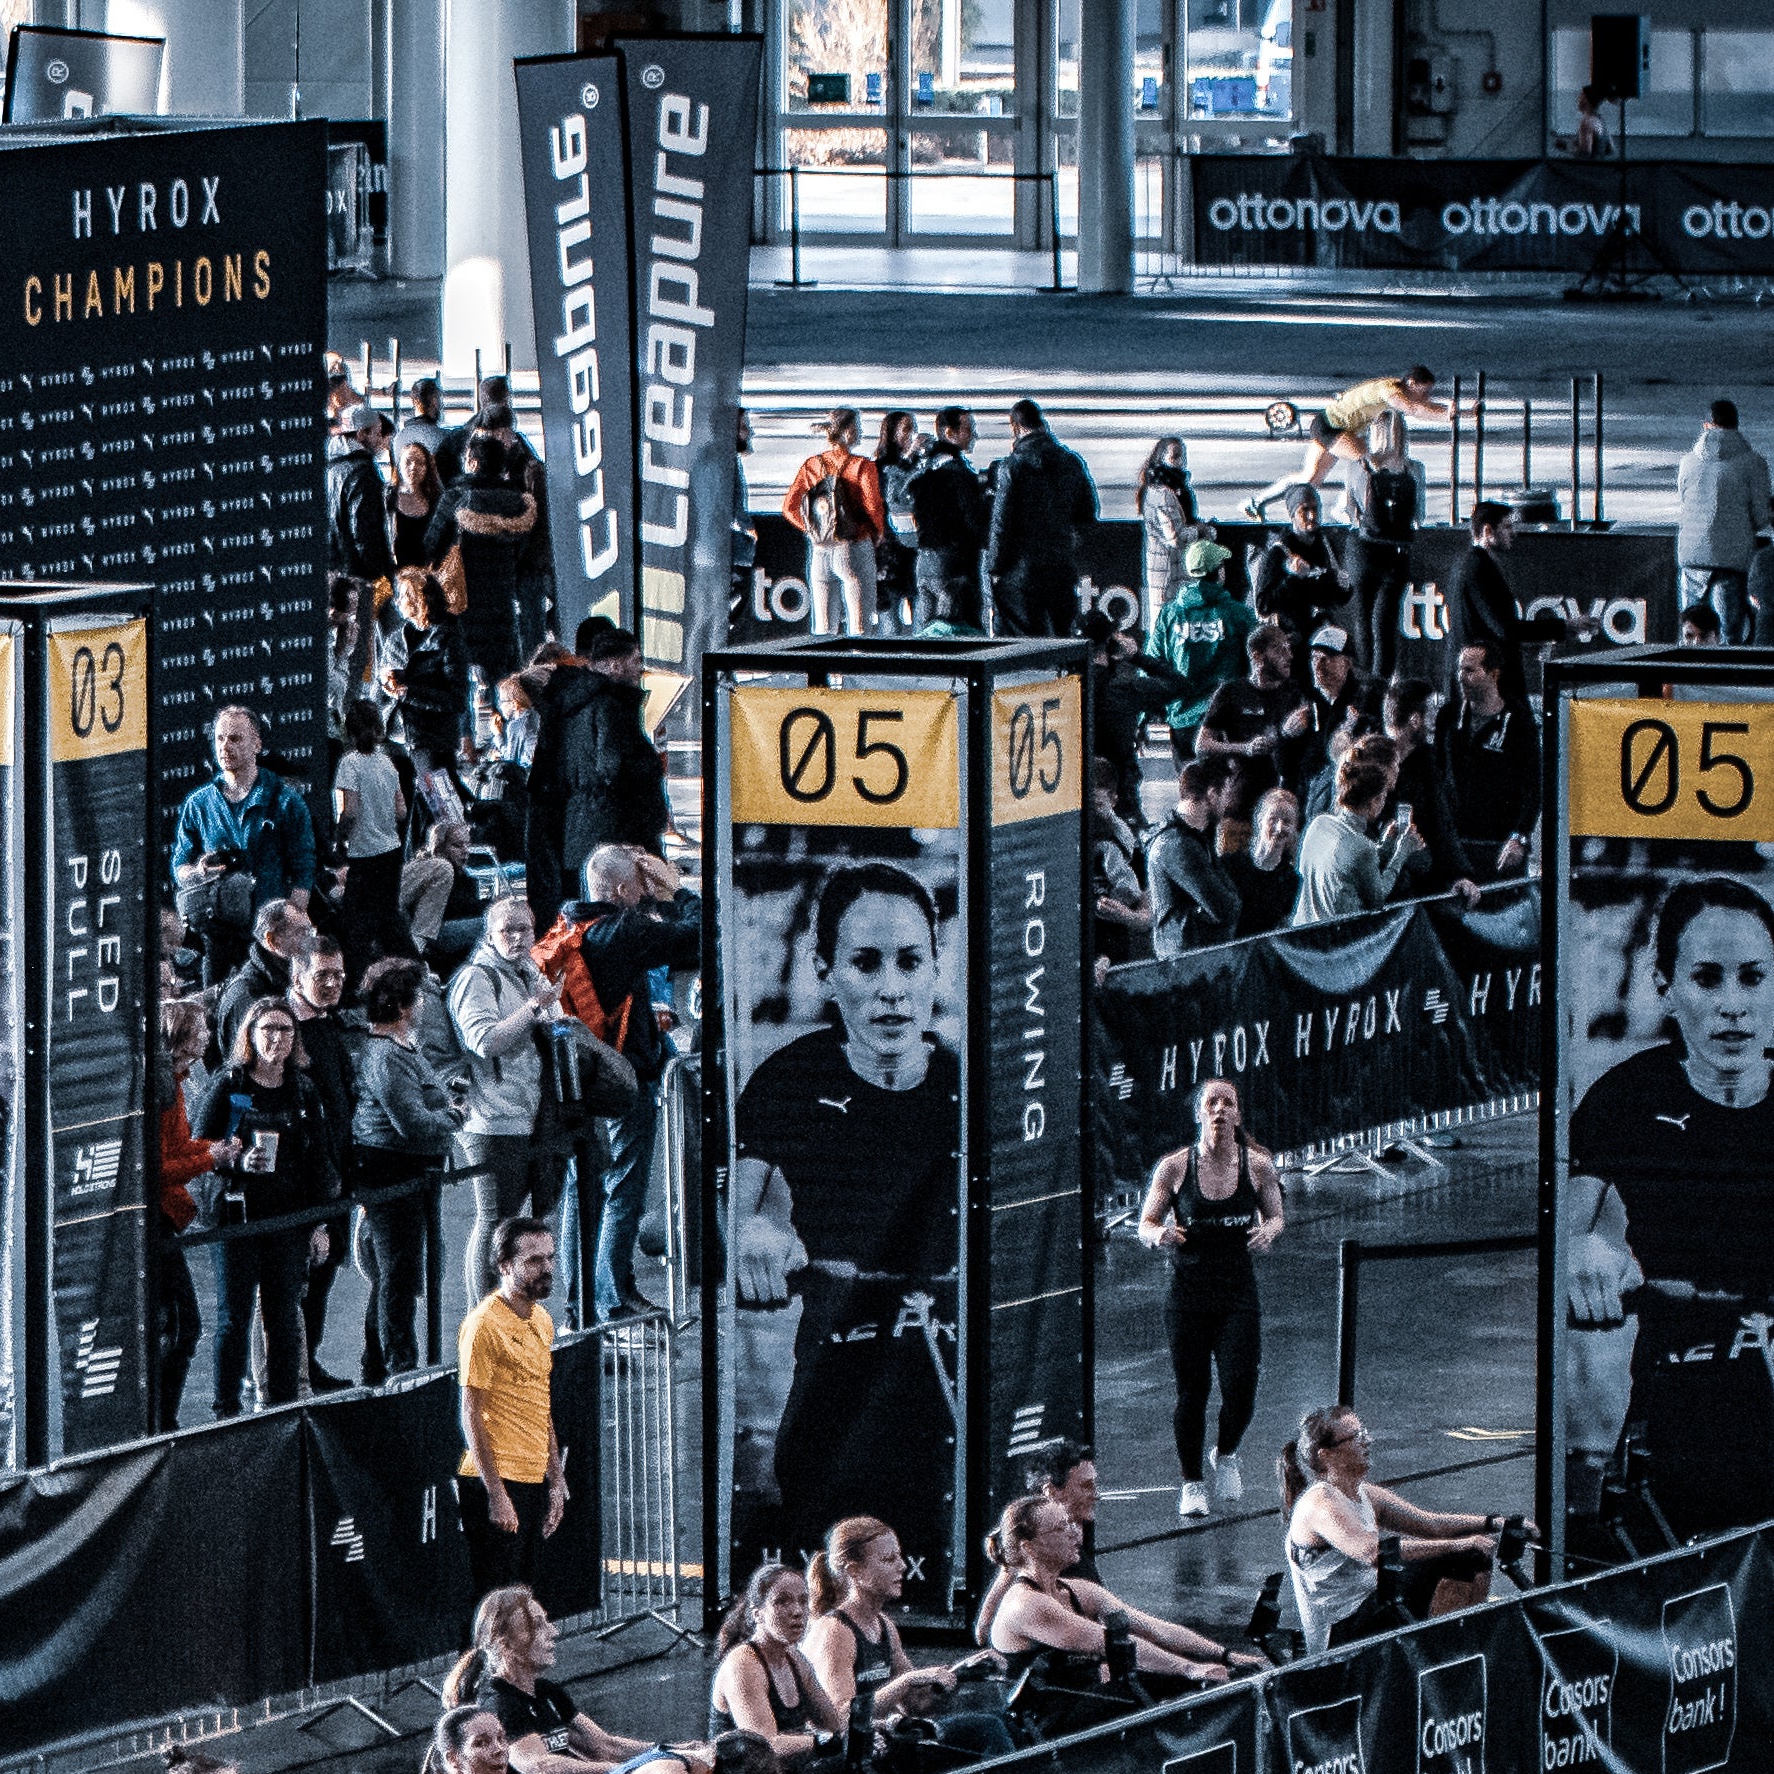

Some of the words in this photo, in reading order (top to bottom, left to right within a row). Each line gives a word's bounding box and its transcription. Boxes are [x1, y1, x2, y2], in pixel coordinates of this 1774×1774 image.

[71, 175, 222, 240] HYROX
[1210, 192, 1401, 233] ottonova
[1442, 196, 1641, 237] ottonova
[1683, 199, 1774, 239] otto
[24, 250, 273, 327] CHAMPIONS
[642, 93, 716, 549] creapure
[70, 641, 126, 740] 03
[779, 706, 911, 805] 05
[1007, 697, 1065, 800] 05
[1619, 718, 1756, 821] 05
[66, 854, 89, 1024] PULL
[95, 848, 122, 1016] SLED
[1021, 869, 1048, 1144] ROWING
[1160, 1017, 1270, 1092] HYROX
[1294, 988, 1402, 1061] HYROX
[1470, 964, 1542, 1018] HYR
[1671, 1639, 1736, 1684] Consors
[1420, 1712, 1482, 1760] Consors
